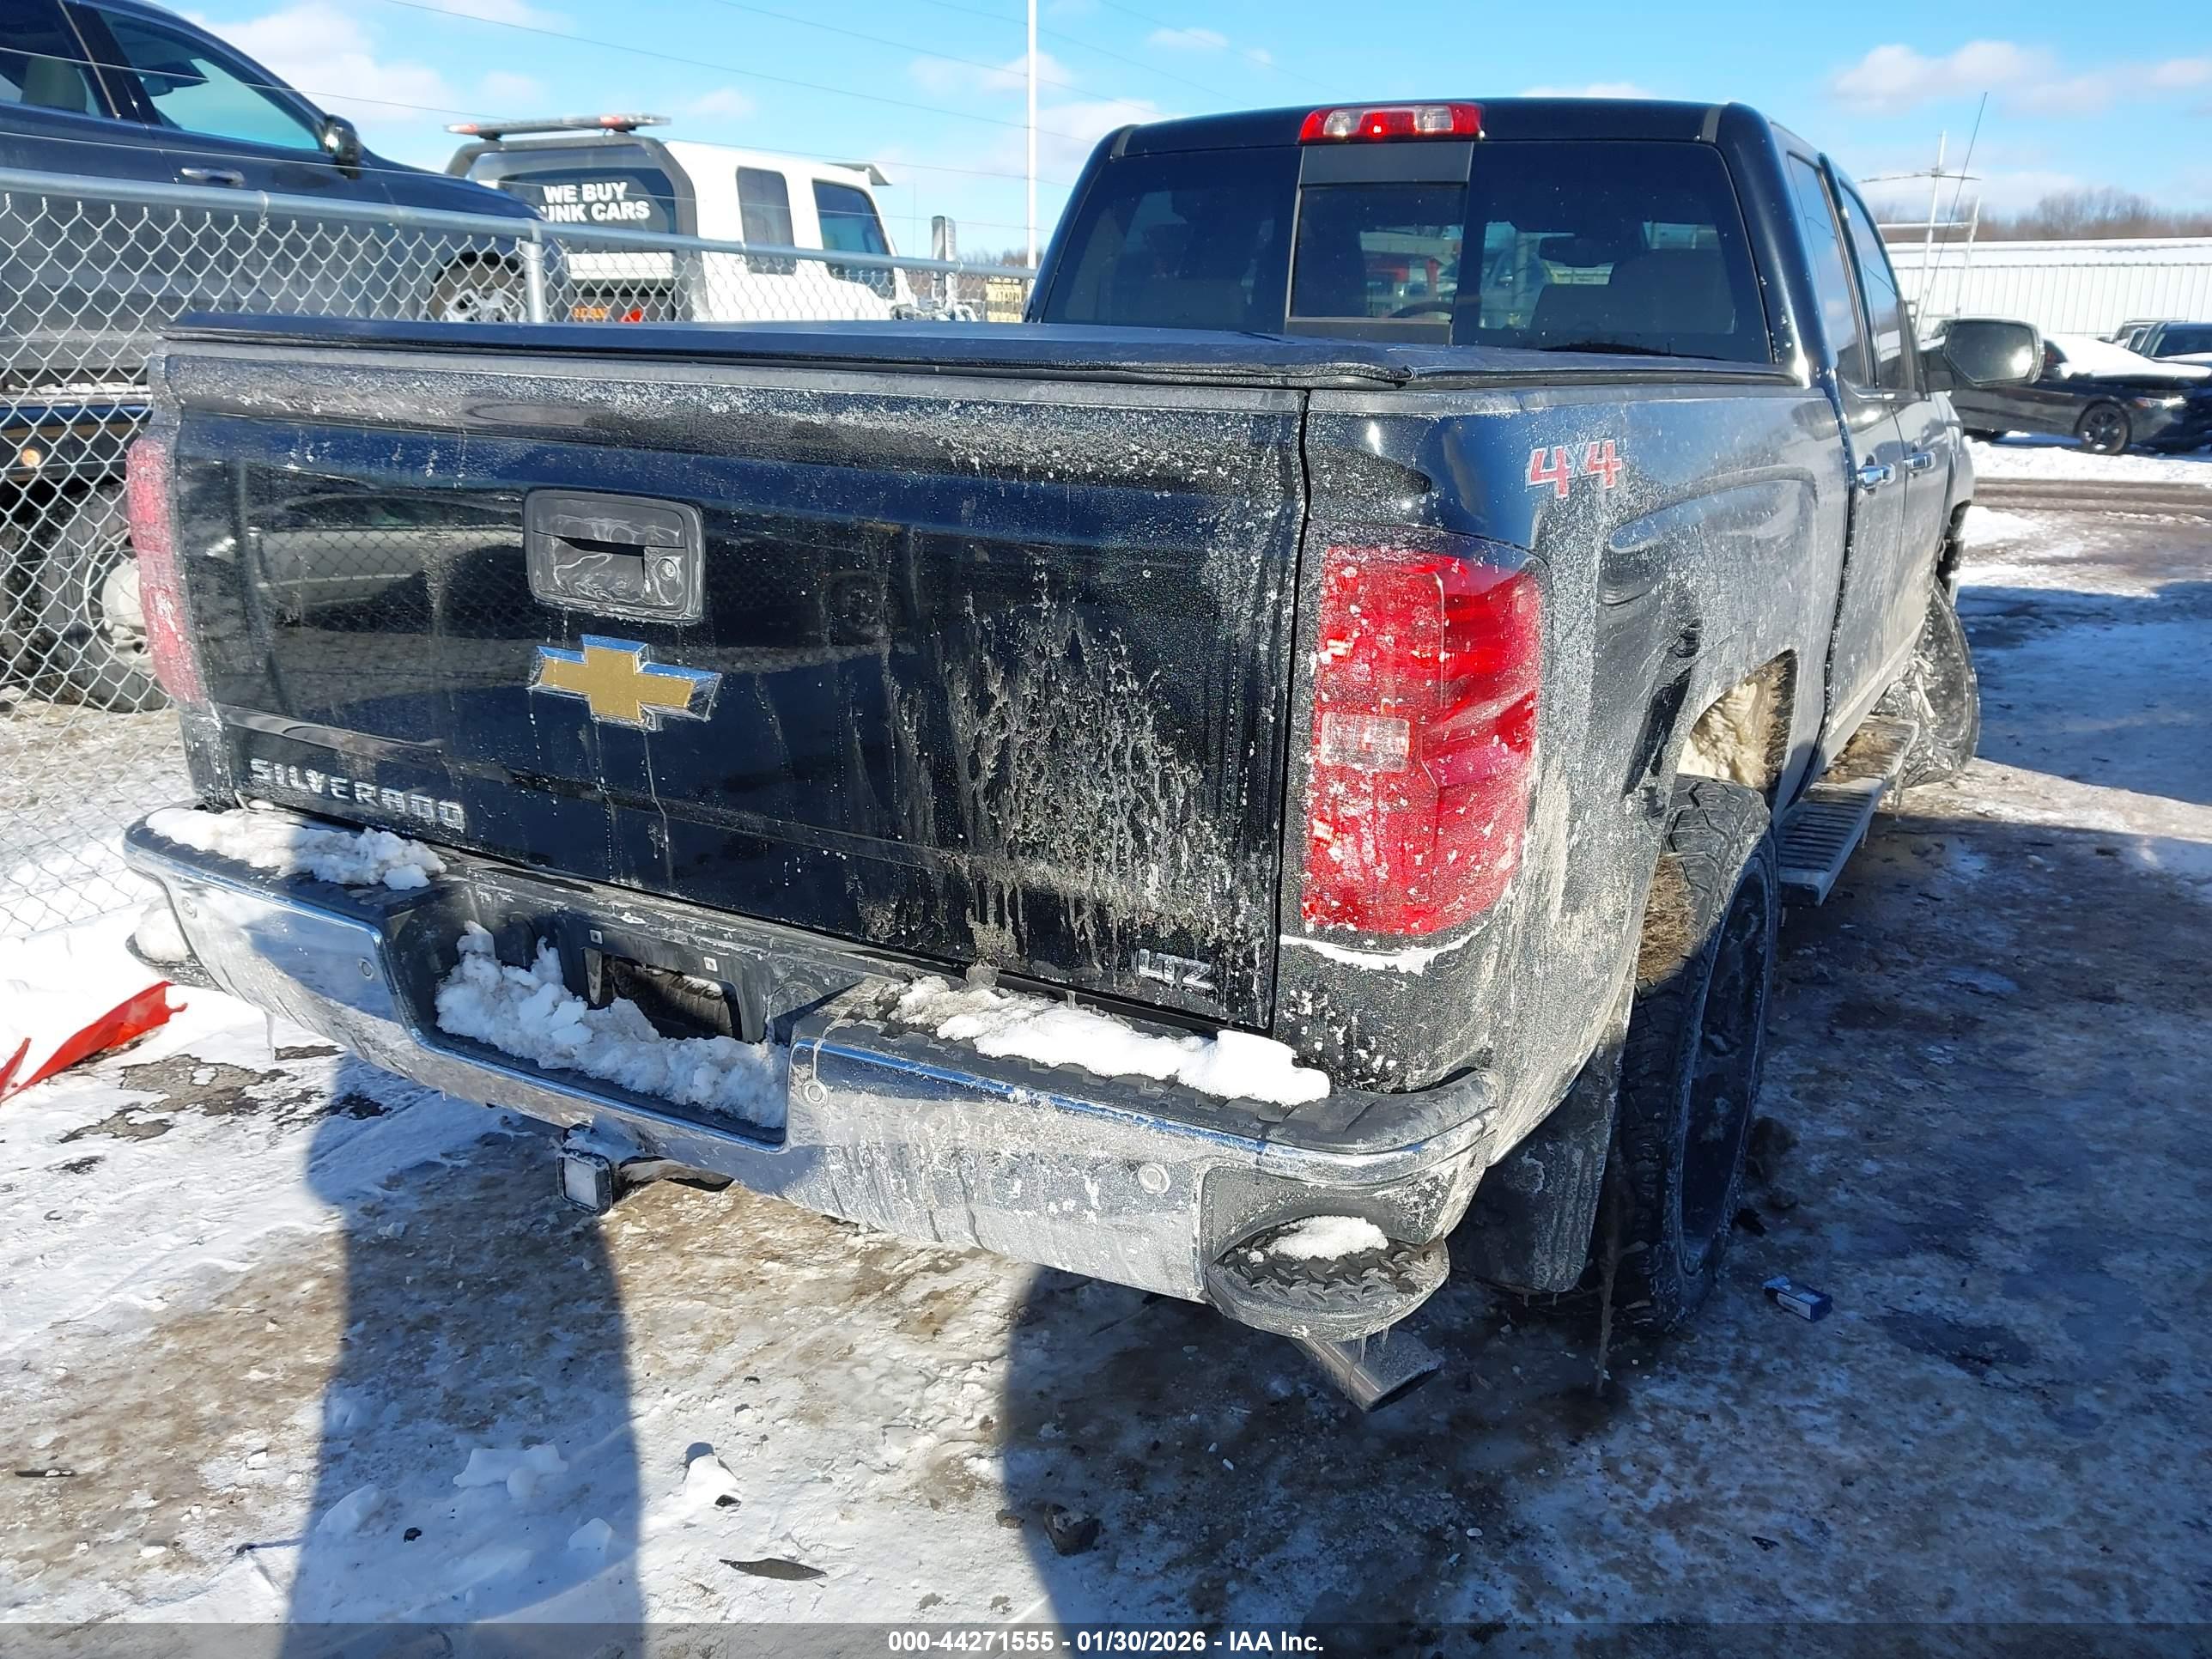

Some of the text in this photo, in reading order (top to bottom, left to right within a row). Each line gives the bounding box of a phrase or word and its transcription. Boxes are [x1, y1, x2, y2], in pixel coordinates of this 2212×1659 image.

[543, 182, 628, 204] WE BUY
[539, 200, 651, 222] UNK CARS
[250, 758, 466, 831] SILVERADO
[1137, 948, 1214, 990] LTZ
